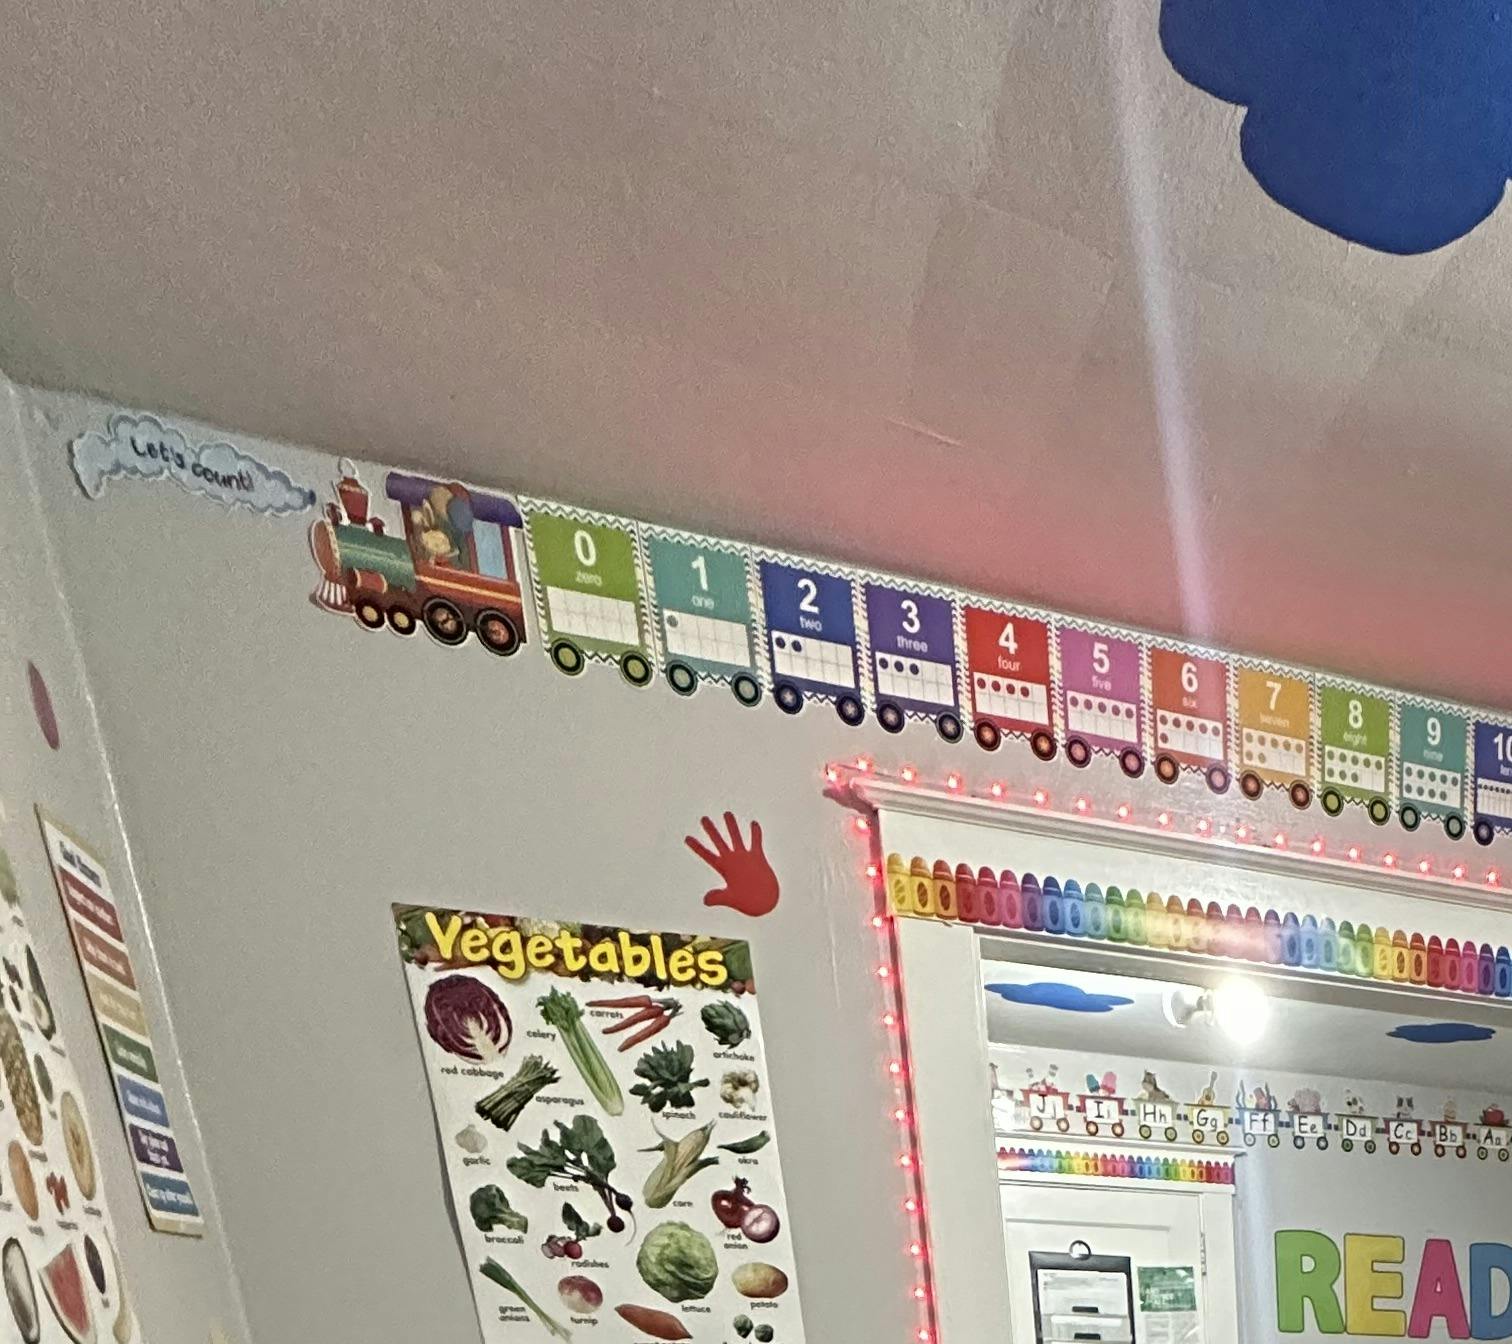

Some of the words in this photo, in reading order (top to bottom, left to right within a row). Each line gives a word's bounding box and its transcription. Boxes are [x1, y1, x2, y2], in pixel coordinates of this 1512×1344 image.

[574, 530, 596, 566] 0
[691, 555, 709, 591] 1
[692, 595, 715, 609] one
[797, 578, 819, 614] 2
[901, 599, 920, 633] 3
[799, 616, 823, 632] two
[897, 635, 928, 653] three
[998, 622, 1018, 654] 4
[998, 655, 1021, 672] four
[1092, 642, 1110, 674] 5
[1181, 662, 1198, 693] 6
[1265, 681, 1282, 710] 7
[1348, 700, 1363, 729] 8
[1427, 717, 1441, 746] 9
[425, 911, 728, 986] Vegetables
[590, 1010, 624, 1020] carrots
[526, 1030, 557, 1042] celery
[713, 1051, 755, 1062] artichoke
[440, 1065, 458, 1076] red
[461, 1067, 504, 1080] cabbage
[535, 1095, 584, 1107] asparagus
[662, 1110, 696, 1120] spinach
[718, 1111, 767, 1122] cauliflower
[1142, 1104, 1167, 1123] Hh
[1196, 1109, 1218, 1132] Gg
[1249, 1112, 1270, 1133] Ff
[1298, 1115, 1318, 1134] Ee
[1346, 1120, 1367, 1138] Dd
[1394, 1123, 1414, 1141] Cc
[1439, 1125, 1457, 1143] Bb
[463, 1156, 491, 1167] garlic
[738, 1156, 759, 1166] okra
[553, 1182, 579, 1193] beets
[672, 1200, 694, 1208] corn
[484, 1233, 525, 1245] broccoli
[726, 1232, 742, 1242] red
[723, 1242, 748, 1250] onion
[571, 1259, 610, 1269] radishes
[498, 1305, 526, 1315] green
[681, 1304, 712, 1314] lettuce
[750, 1301, 779, 1310] potato
[498, 1315, 530, 1323] onions
[570, 1316, 599, 1327] turnip
